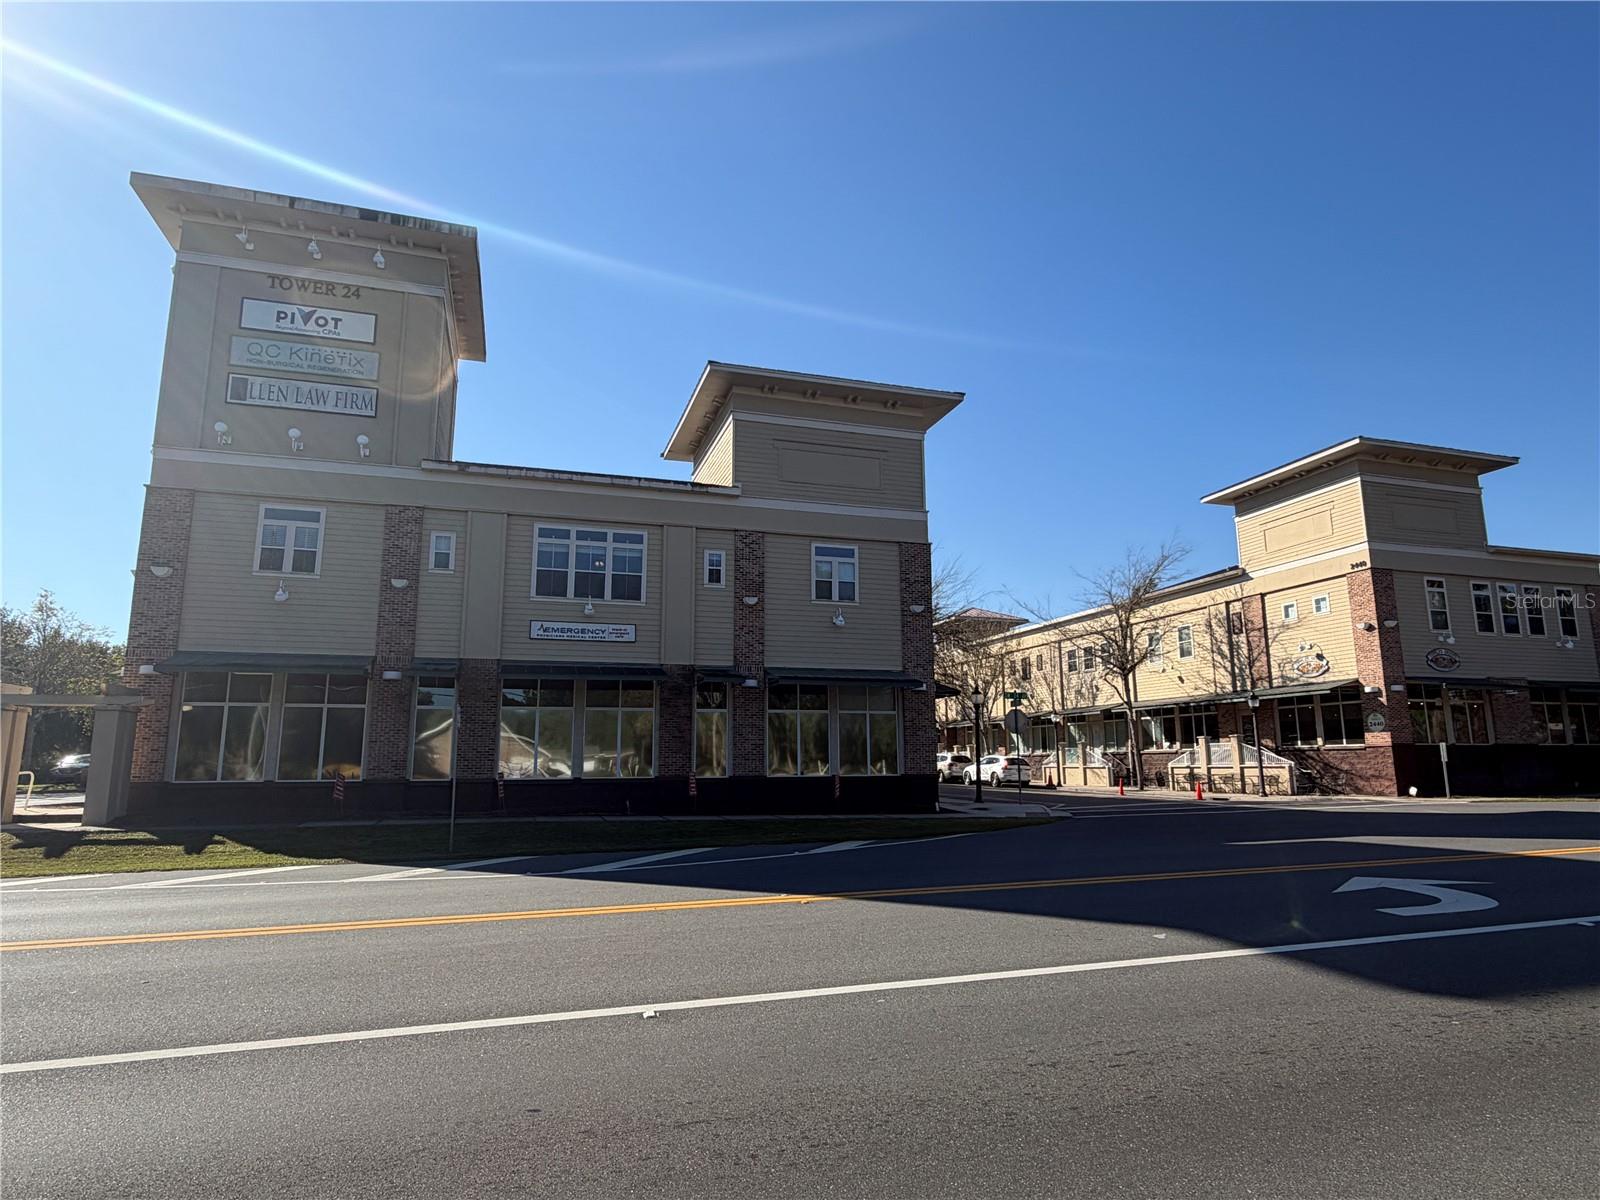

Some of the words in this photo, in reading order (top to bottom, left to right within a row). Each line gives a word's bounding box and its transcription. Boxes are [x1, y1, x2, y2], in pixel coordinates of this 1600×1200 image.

[268, 276, 336, 297] TOWER
[341, 286, 361, 300] 24
[275, 307, 342, 329] PIVOT
[247, 342, 281, 359] QC
[295, 386, 331, 407] LAW
[334, 391, 375, 412] FIRM
[543, 626, 607, 635] EMERGENCY
